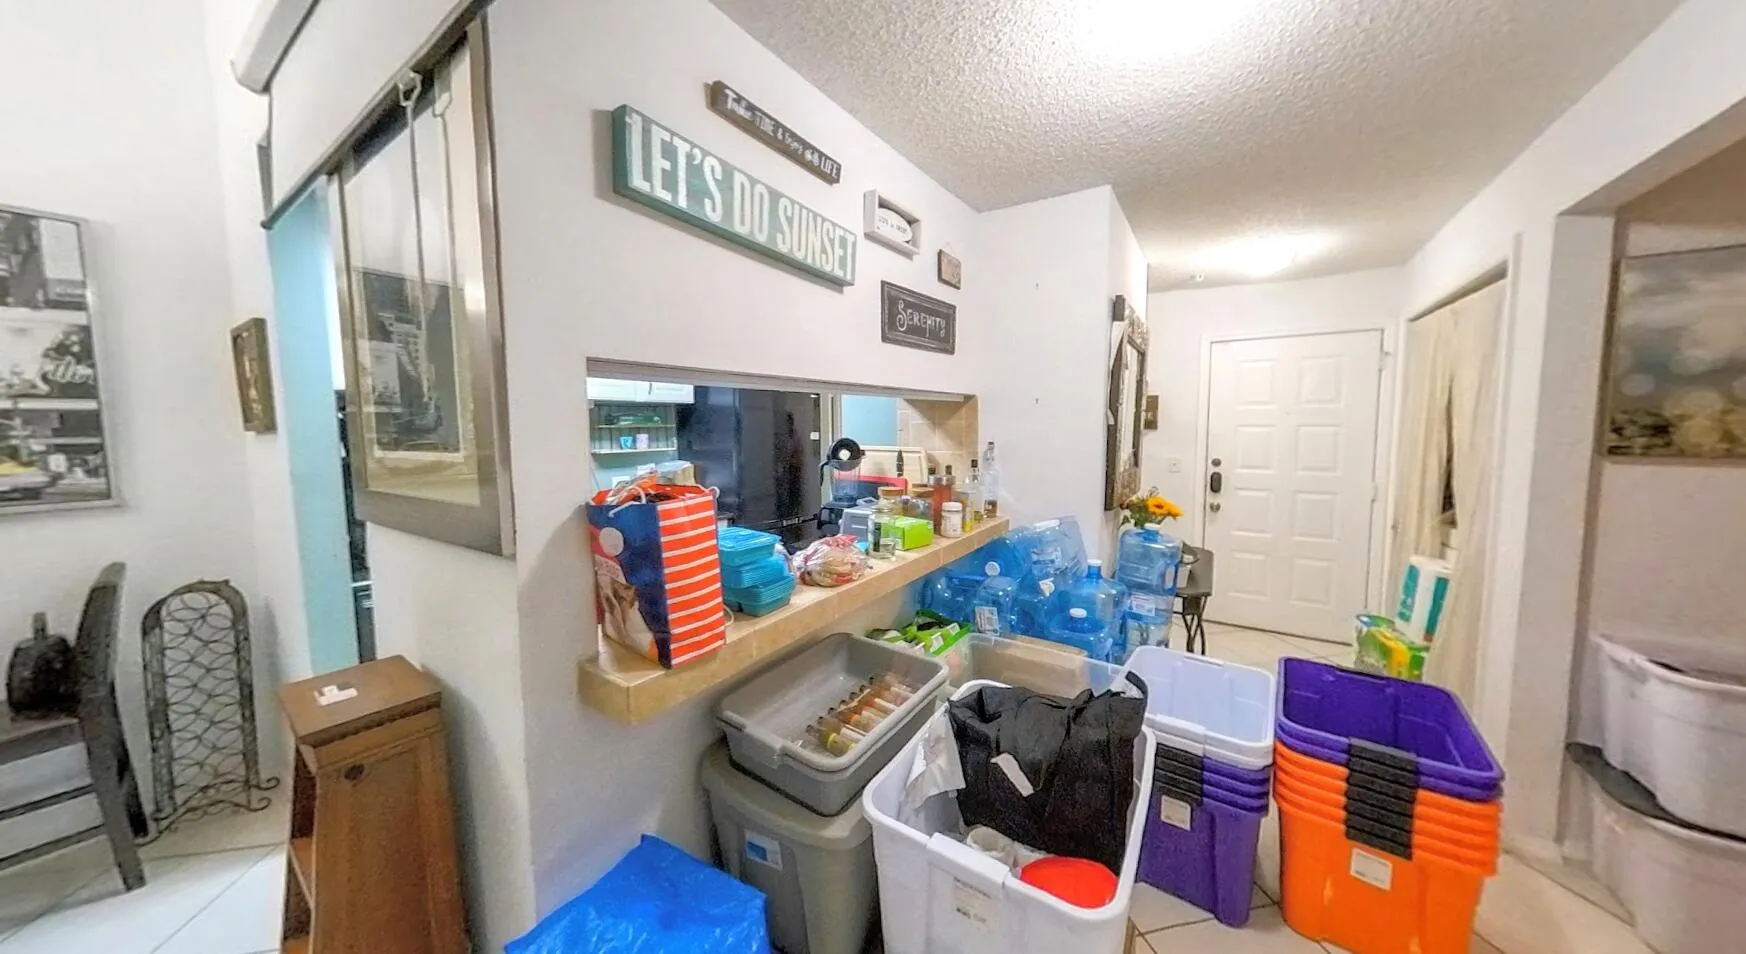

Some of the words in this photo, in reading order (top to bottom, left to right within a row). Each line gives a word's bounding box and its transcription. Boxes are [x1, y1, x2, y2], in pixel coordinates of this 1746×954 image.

[624, 111, 724, 222] LET'S
[732, 169, 770, 243] DO
[776, 196, 856, 281] SUNSET
[820, 156, 839, 179] LIFE
